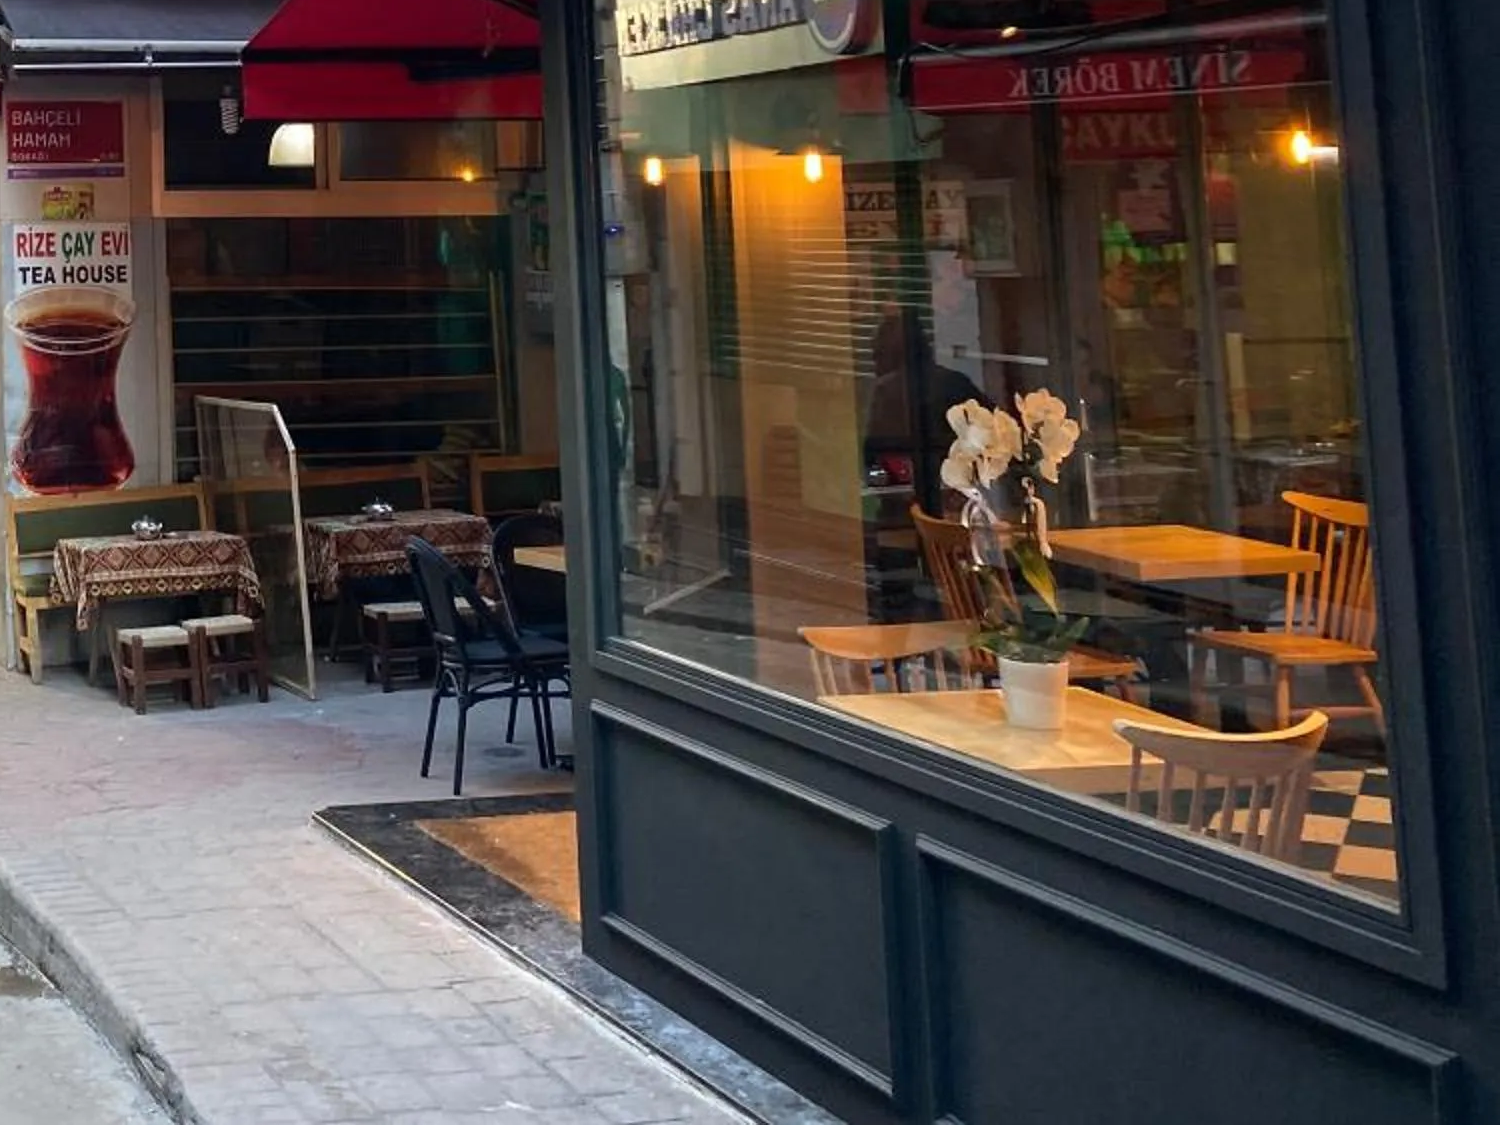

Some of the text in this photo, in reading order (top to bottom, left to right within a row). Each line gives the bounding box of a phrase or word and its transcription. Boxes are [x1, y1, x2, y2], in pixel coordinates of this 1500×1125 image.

[12, 132, 71, 148] HAMAM
[16, 227, 57, 258] RİZE
[61, 231, 95, 263] ÇAY
[19, 264, 129, 285] TEA HOUSE
